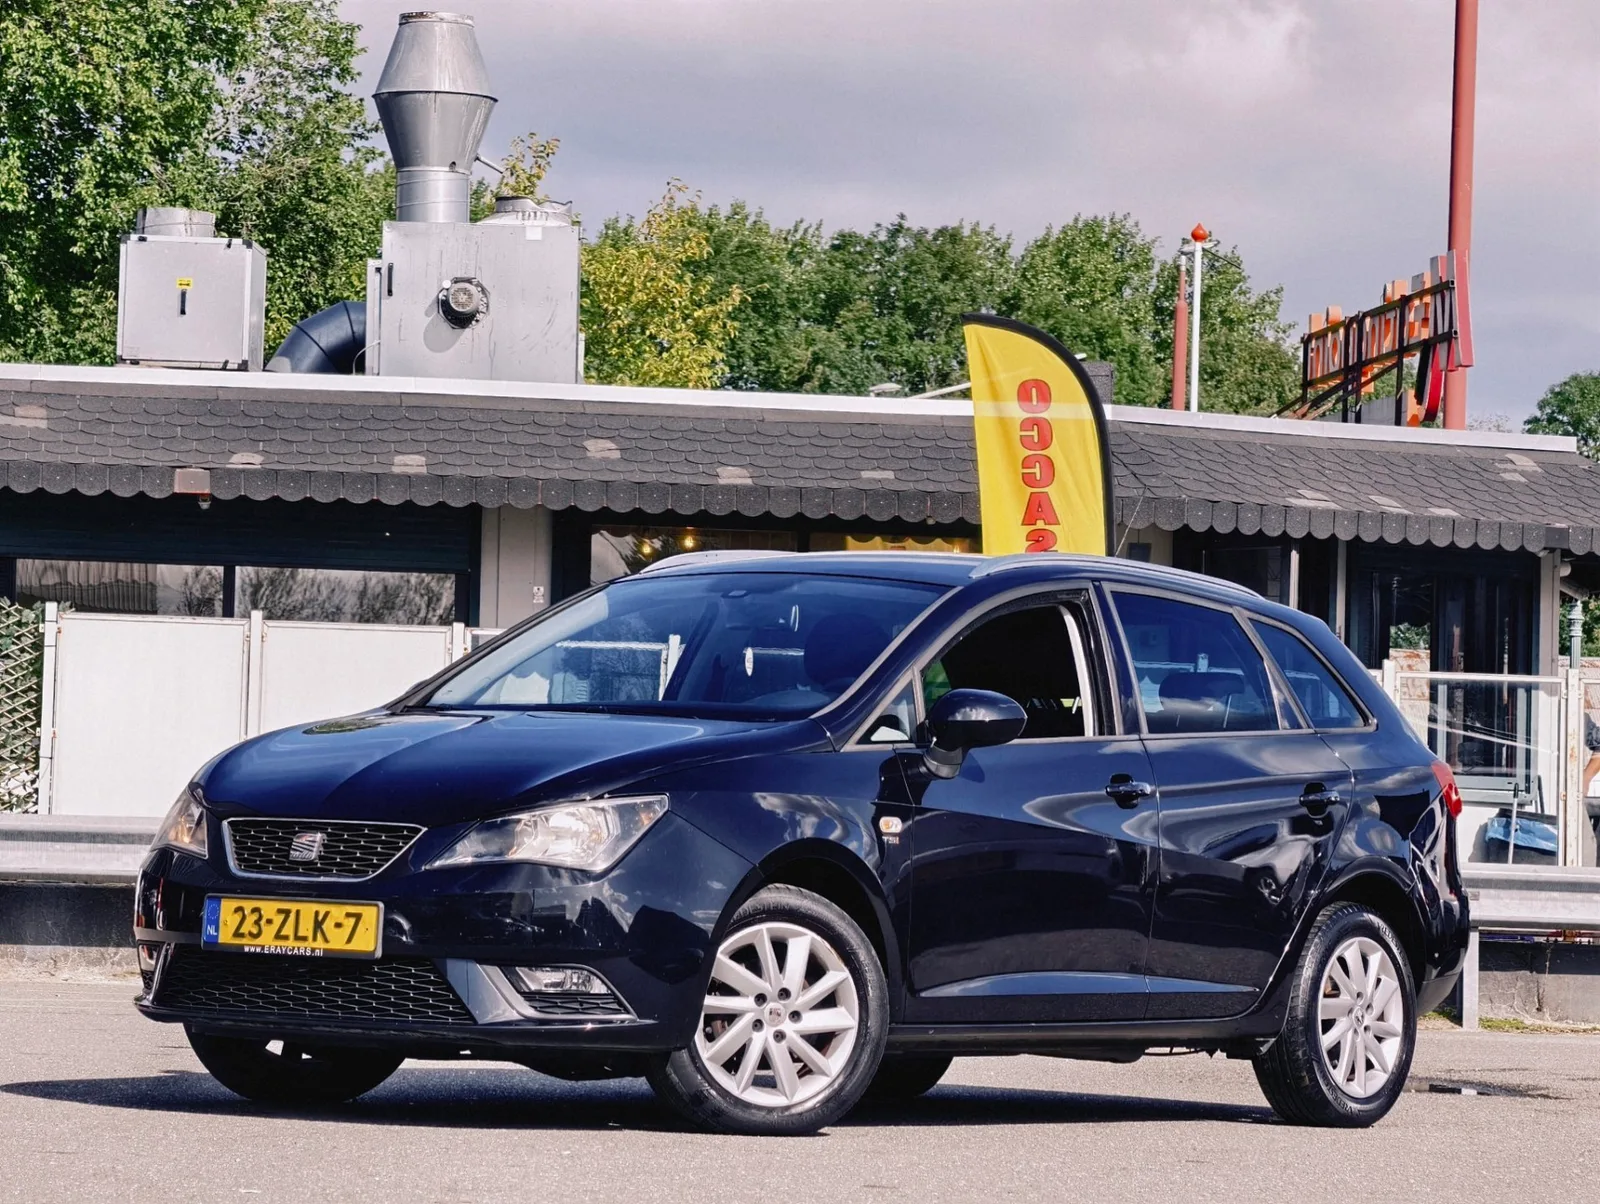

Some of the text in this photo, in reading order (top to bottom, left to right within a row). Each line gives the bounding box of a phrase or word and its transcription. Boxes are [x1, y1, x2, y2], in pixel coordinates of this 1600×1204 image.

[207, 925, 218, 936] NL
[232, 906, 363, 945] 23-ZLK-7
[244, 945, 323, 957] www.ERAYCARS.nl
